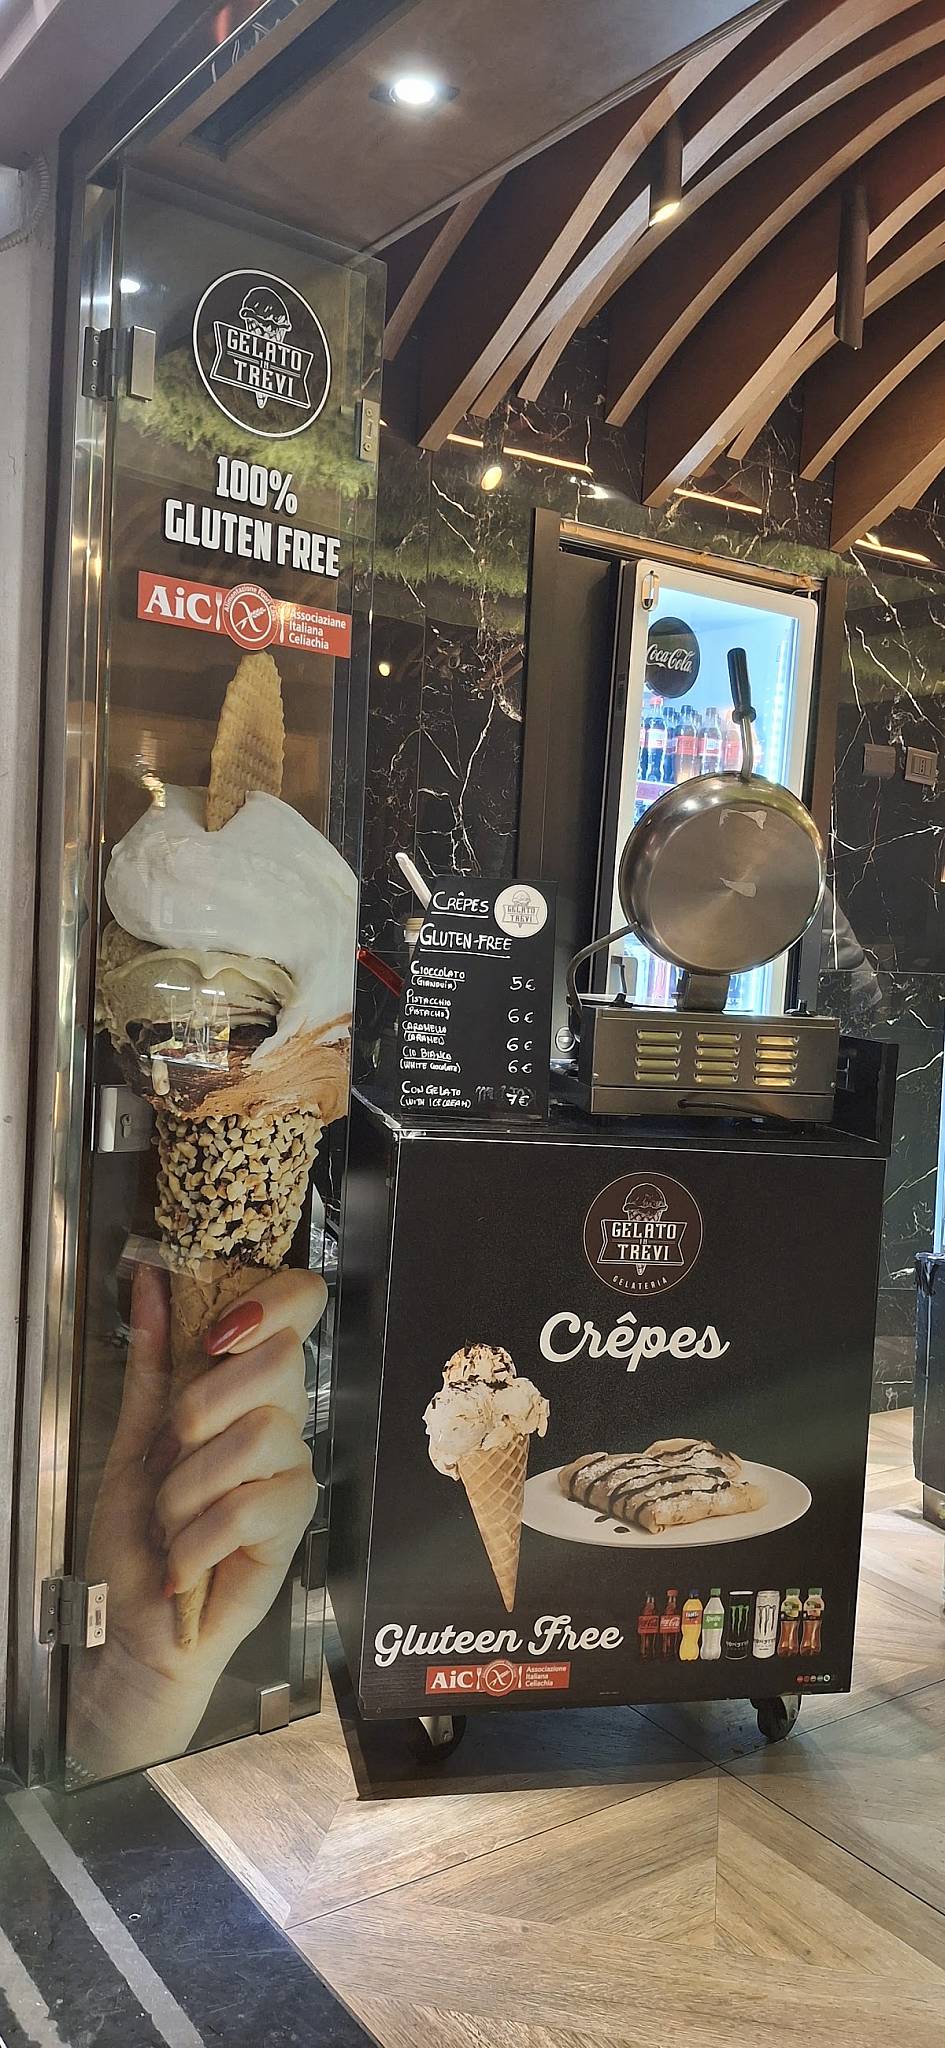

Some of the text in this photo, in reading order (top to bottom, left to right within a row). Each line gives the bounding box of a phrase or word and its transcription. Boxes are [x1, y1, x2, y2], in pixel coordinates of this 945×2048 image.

[226, 328, 303, 372] GELATO
[234, 358, 294, 398] TREVI
[215, 455, 298, 515] 100%
[165, 498, 341, 578] GLUTEN FREE
[143, 584, 213, 625] AiC
[288, 620, 324, 637] Italiana
[288, 632, 329, 650] Celiachia
[611, 1221, 677, 1240] GELATO
[617, 1243, 670, 1261] TREVI
[612, 1275, 669, 1291] GELATERIA
[539, 1311, 731, 1373] Crêpes
[373, 1613, 625, 1668] Gluteen Free
[430, 1670, 474, 1690] AiC
